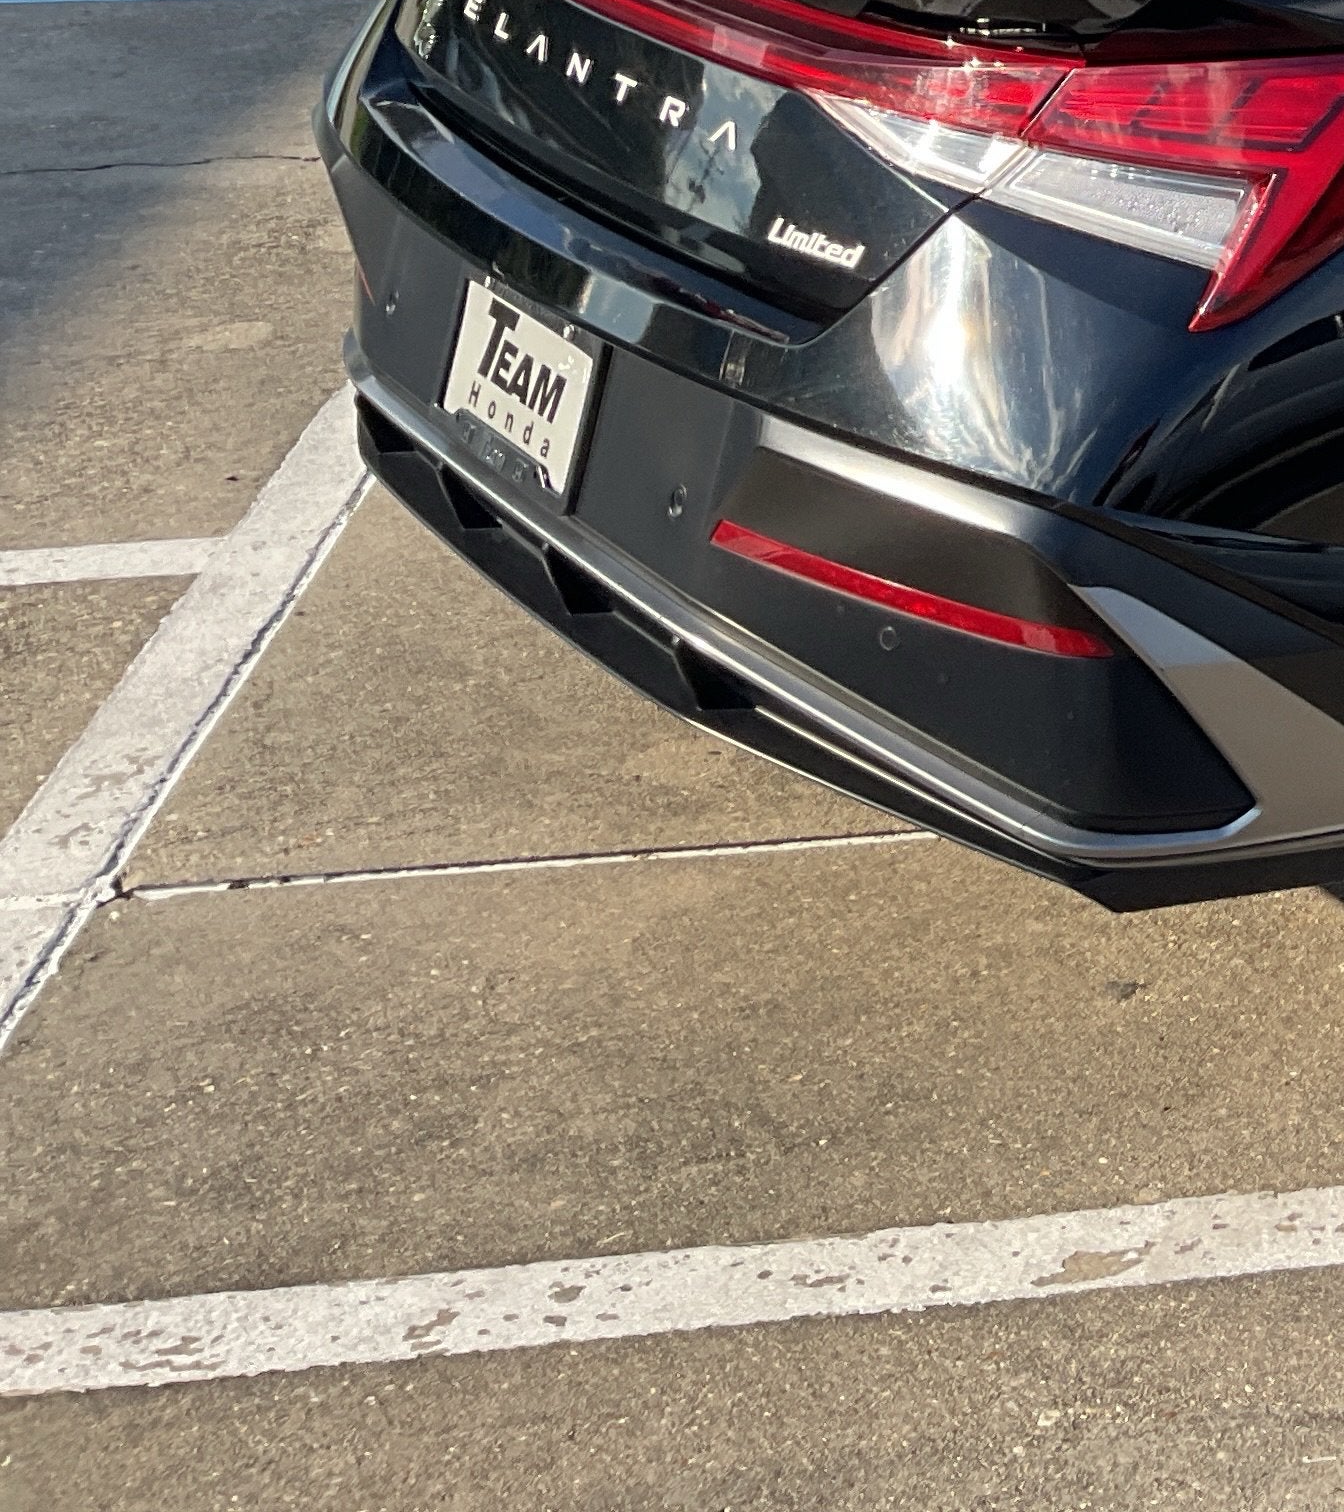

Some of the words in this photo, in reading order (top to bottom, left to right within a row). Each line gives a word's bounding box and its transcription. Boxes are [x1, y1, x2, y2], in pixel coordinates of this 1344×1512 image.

[767, 216, 866, 269] Limited
[477, 296, 568, 424] TEAM
[468, 380, 551, 458] Honda
